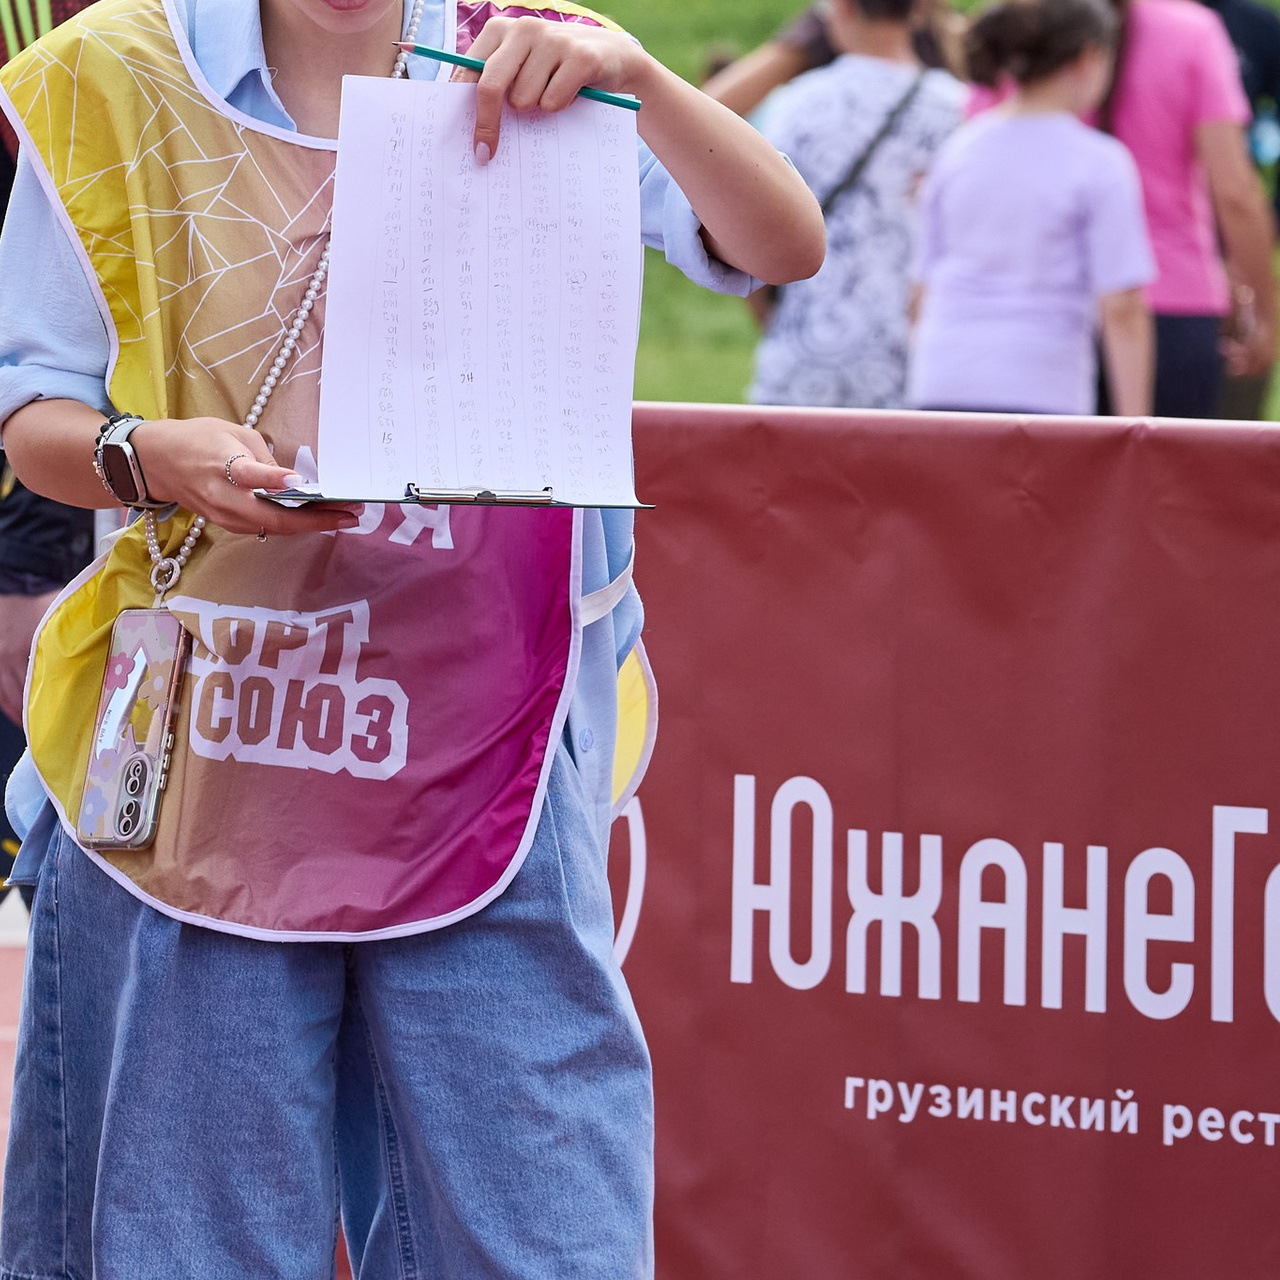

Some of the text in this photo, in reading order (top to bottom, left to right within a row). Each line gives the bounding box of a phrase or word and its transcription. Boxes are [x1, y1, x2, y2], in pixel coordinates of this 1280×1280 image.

[388, 326, 397, 334] 10
[462, 301, 472, 310] 16
[382, 433, 392, 444] 51
[170, 609, 354, 675] ОРТ
[195, 671, 395, 764] СОЮЗ
[730, 774, 1280, 1023] ЮжанеГ
[843, 1076, 1280, 1146] грузинский рест
